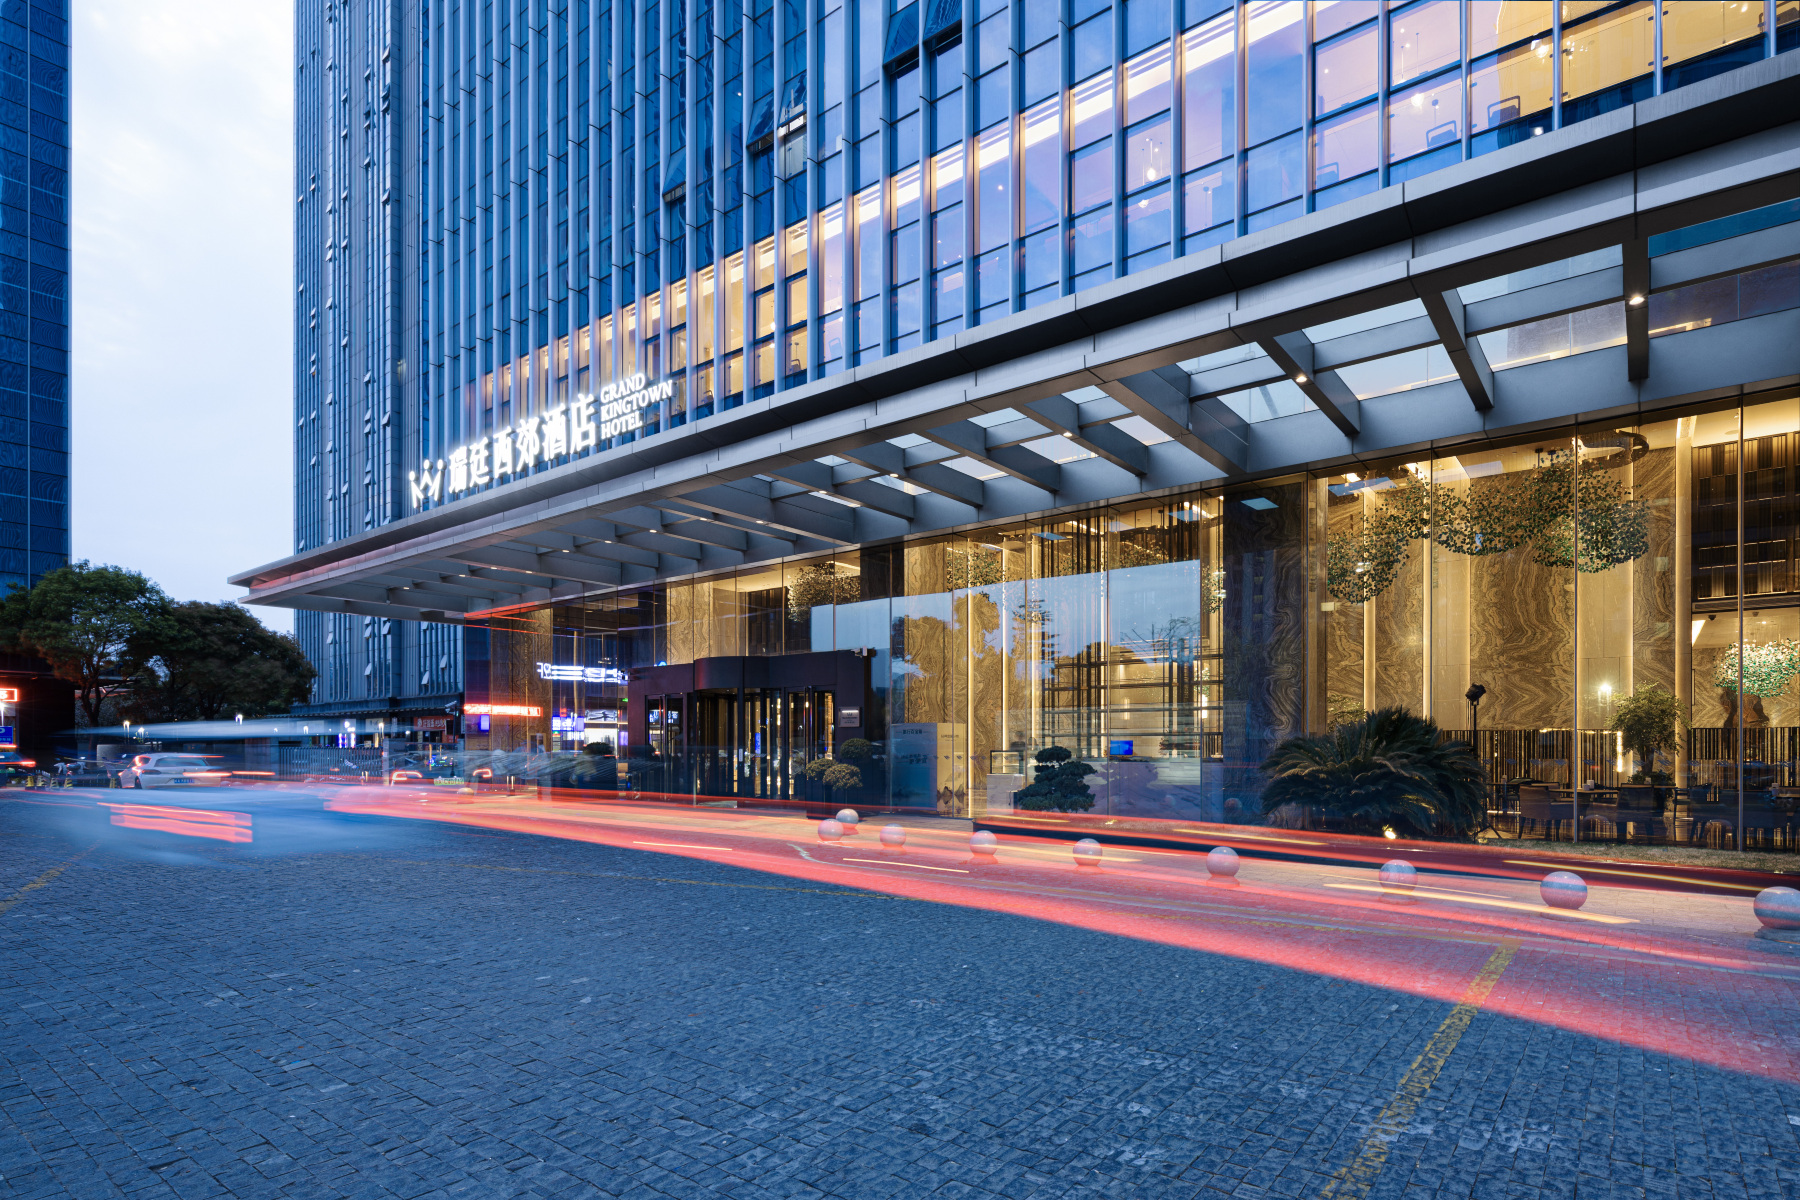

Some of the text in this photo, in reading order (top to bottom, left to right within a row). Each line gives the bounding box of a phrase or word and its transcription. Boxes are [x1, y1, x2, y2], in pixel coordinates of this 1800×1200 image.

[601, 373, 645, 403] GRAND
[601, 380, 673, 421] KINGTOWN
[601, 411, 642, 439] HOTEL
[449, 394, 596, 493] 瑞廷西郊酒店
